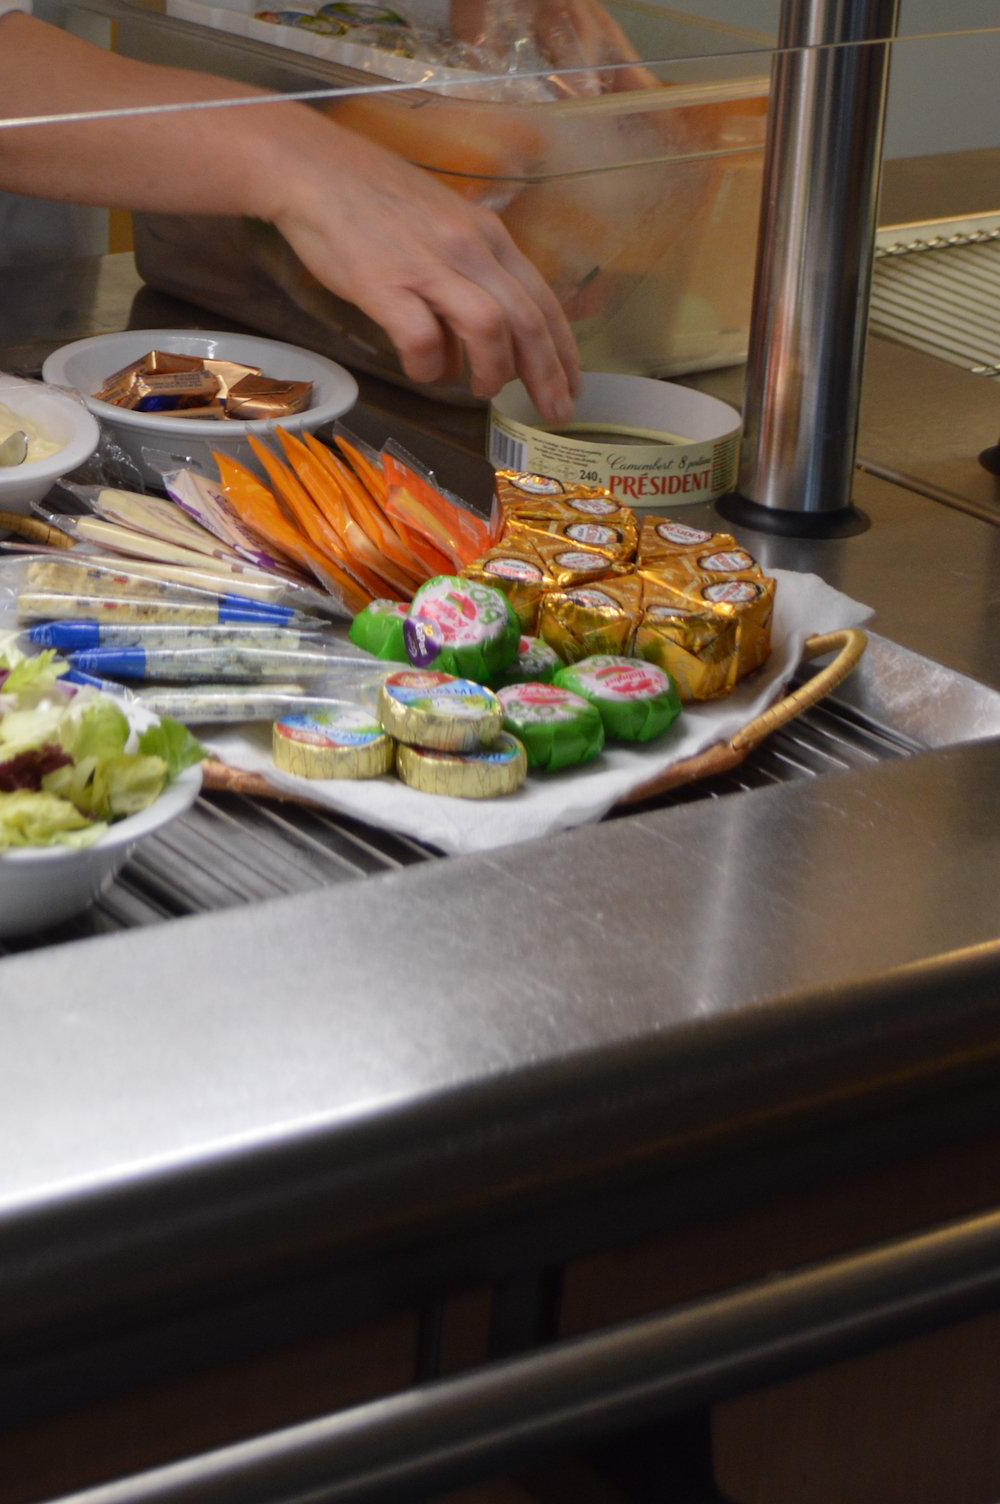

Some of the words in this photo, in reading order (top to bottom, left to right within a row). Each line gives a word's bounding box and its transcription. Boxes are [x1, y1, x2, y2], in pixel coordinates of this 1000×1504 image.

[606, 453, 675, 471] Camembert
[678, 456, 688, 470] 8
[580, 469, 598, 482] 240
[608, 469, 711, 500] PRÉSIDENT
